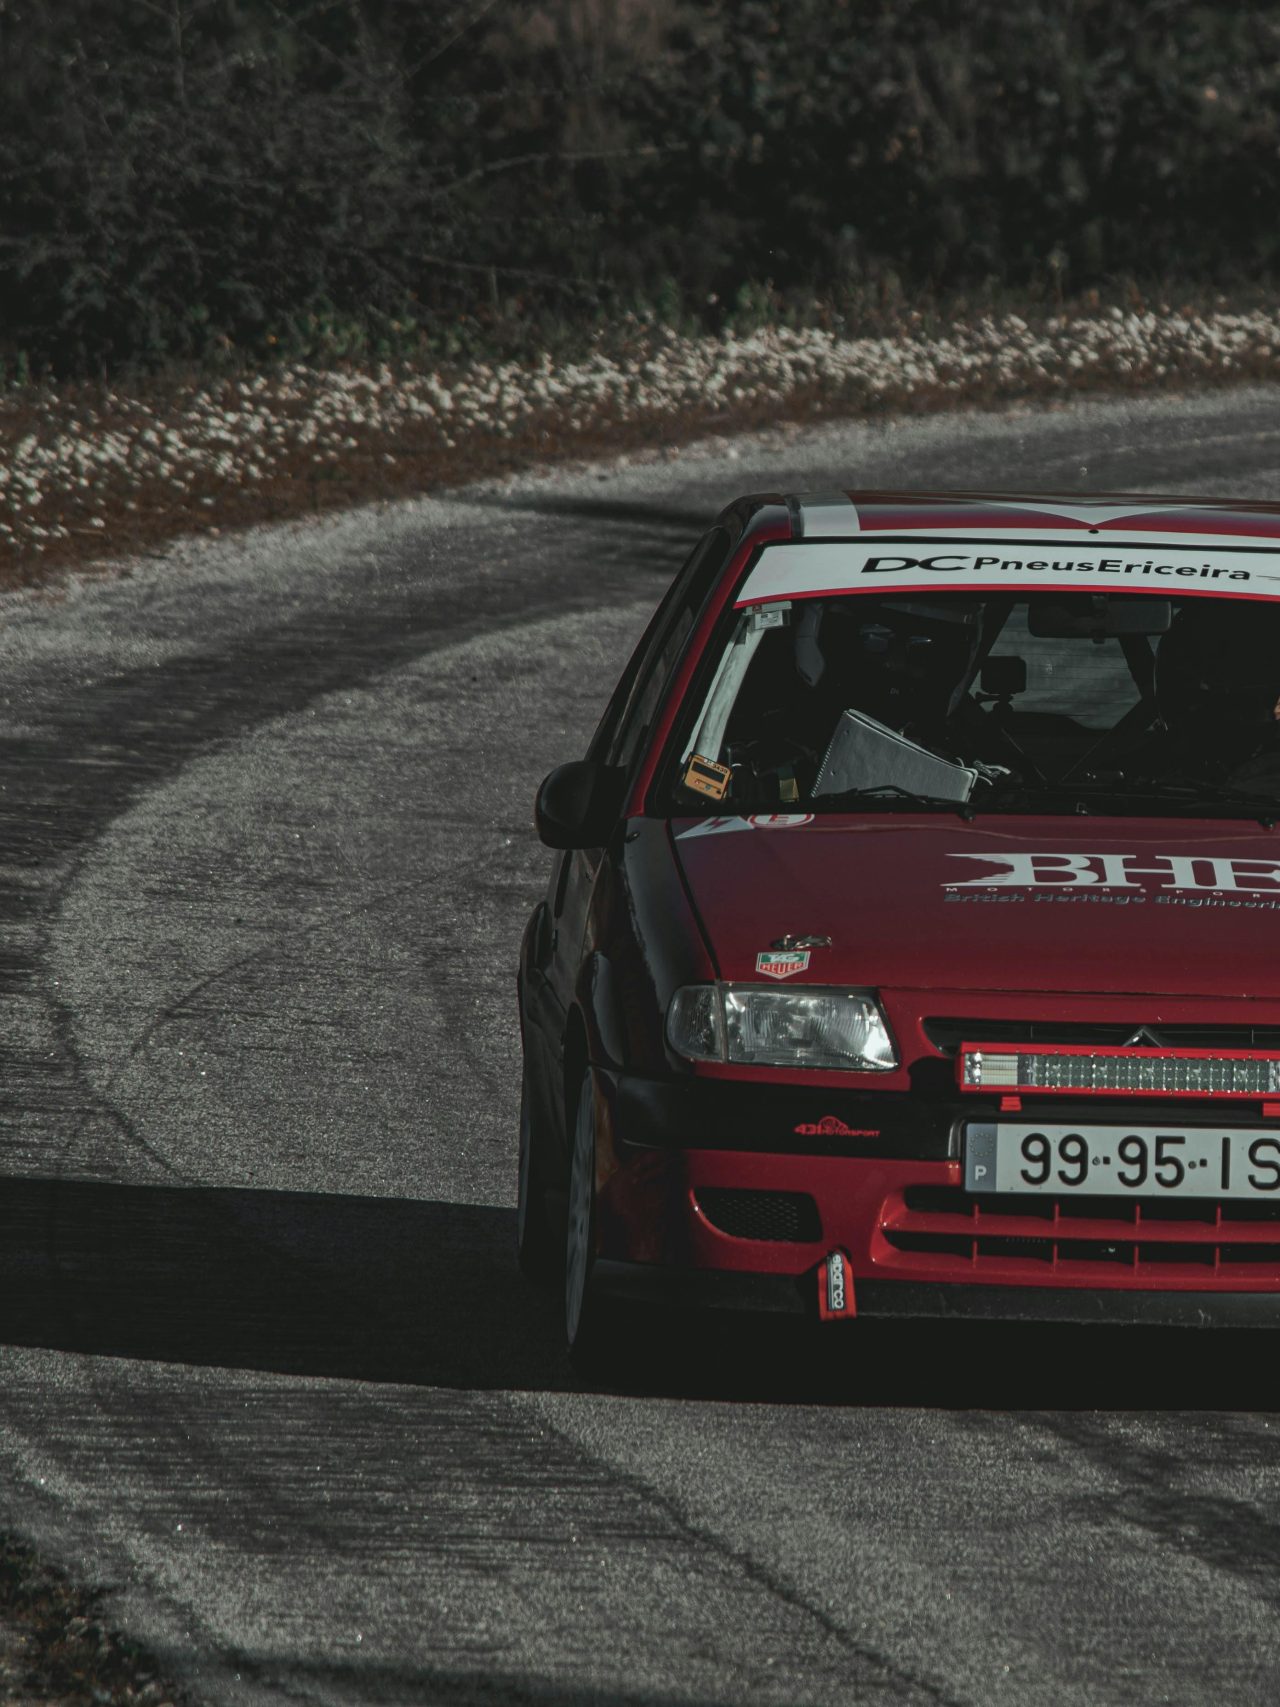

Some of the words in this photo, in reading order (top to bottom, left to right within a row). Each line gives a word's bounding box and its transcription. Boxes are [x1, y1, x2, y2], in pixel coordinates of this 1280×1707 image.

[943, 893, 1025, 903] British
[1034, 894, 1146, 905] Heritage
[761, 963, 804, 975] HEUER
[974, 1166, 987, 1181] P
